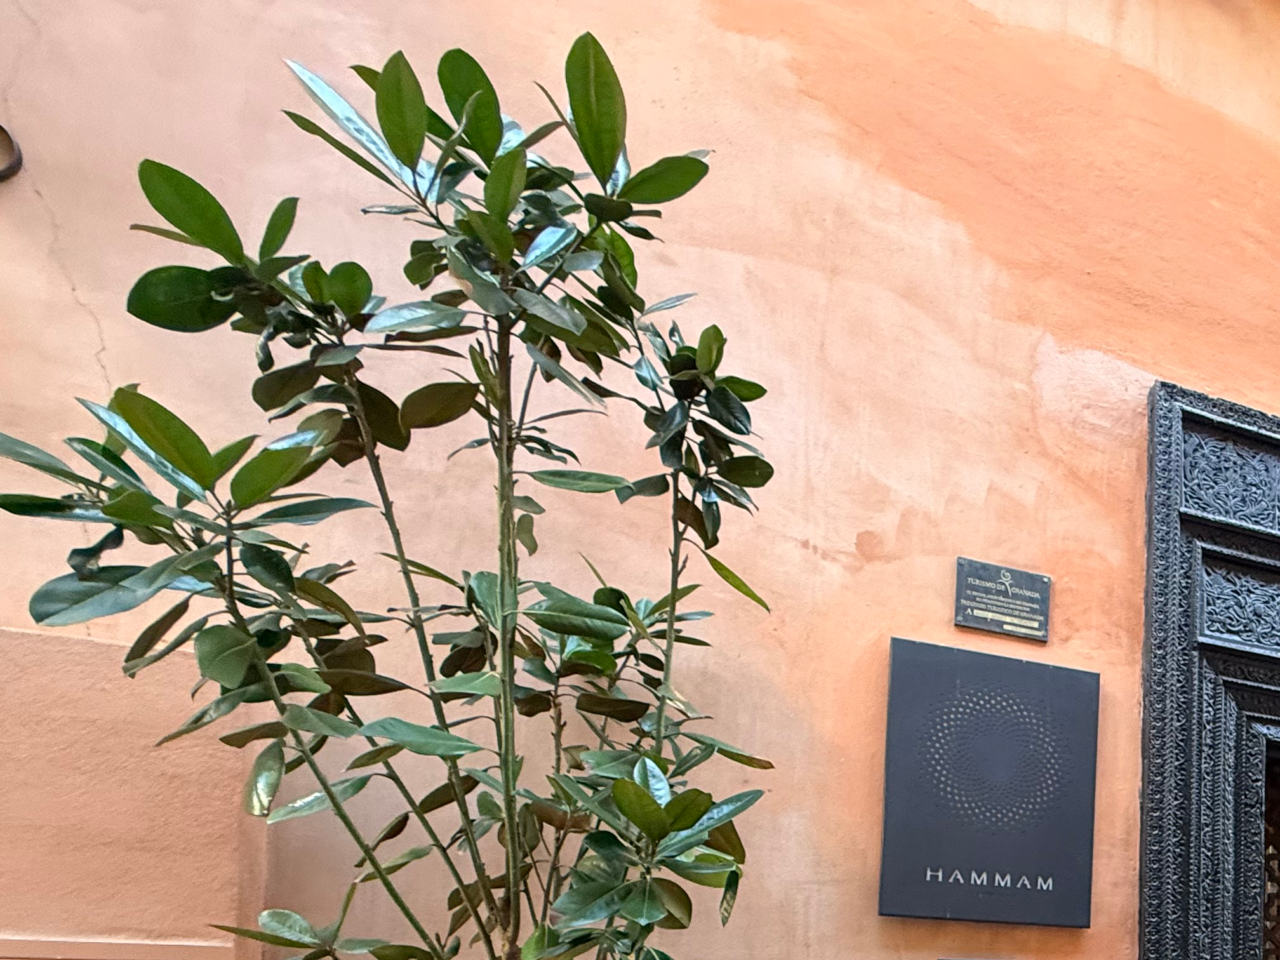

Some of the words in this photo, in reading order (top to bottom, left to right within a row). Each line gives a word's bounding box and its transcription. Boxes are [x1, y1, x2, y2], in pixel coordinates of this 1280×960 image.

[966, 577, 997, 589] TURISMO
[1011, 587, 1041, 599] GRANADA
[925, 867, 1053, 891] HAMMAM
